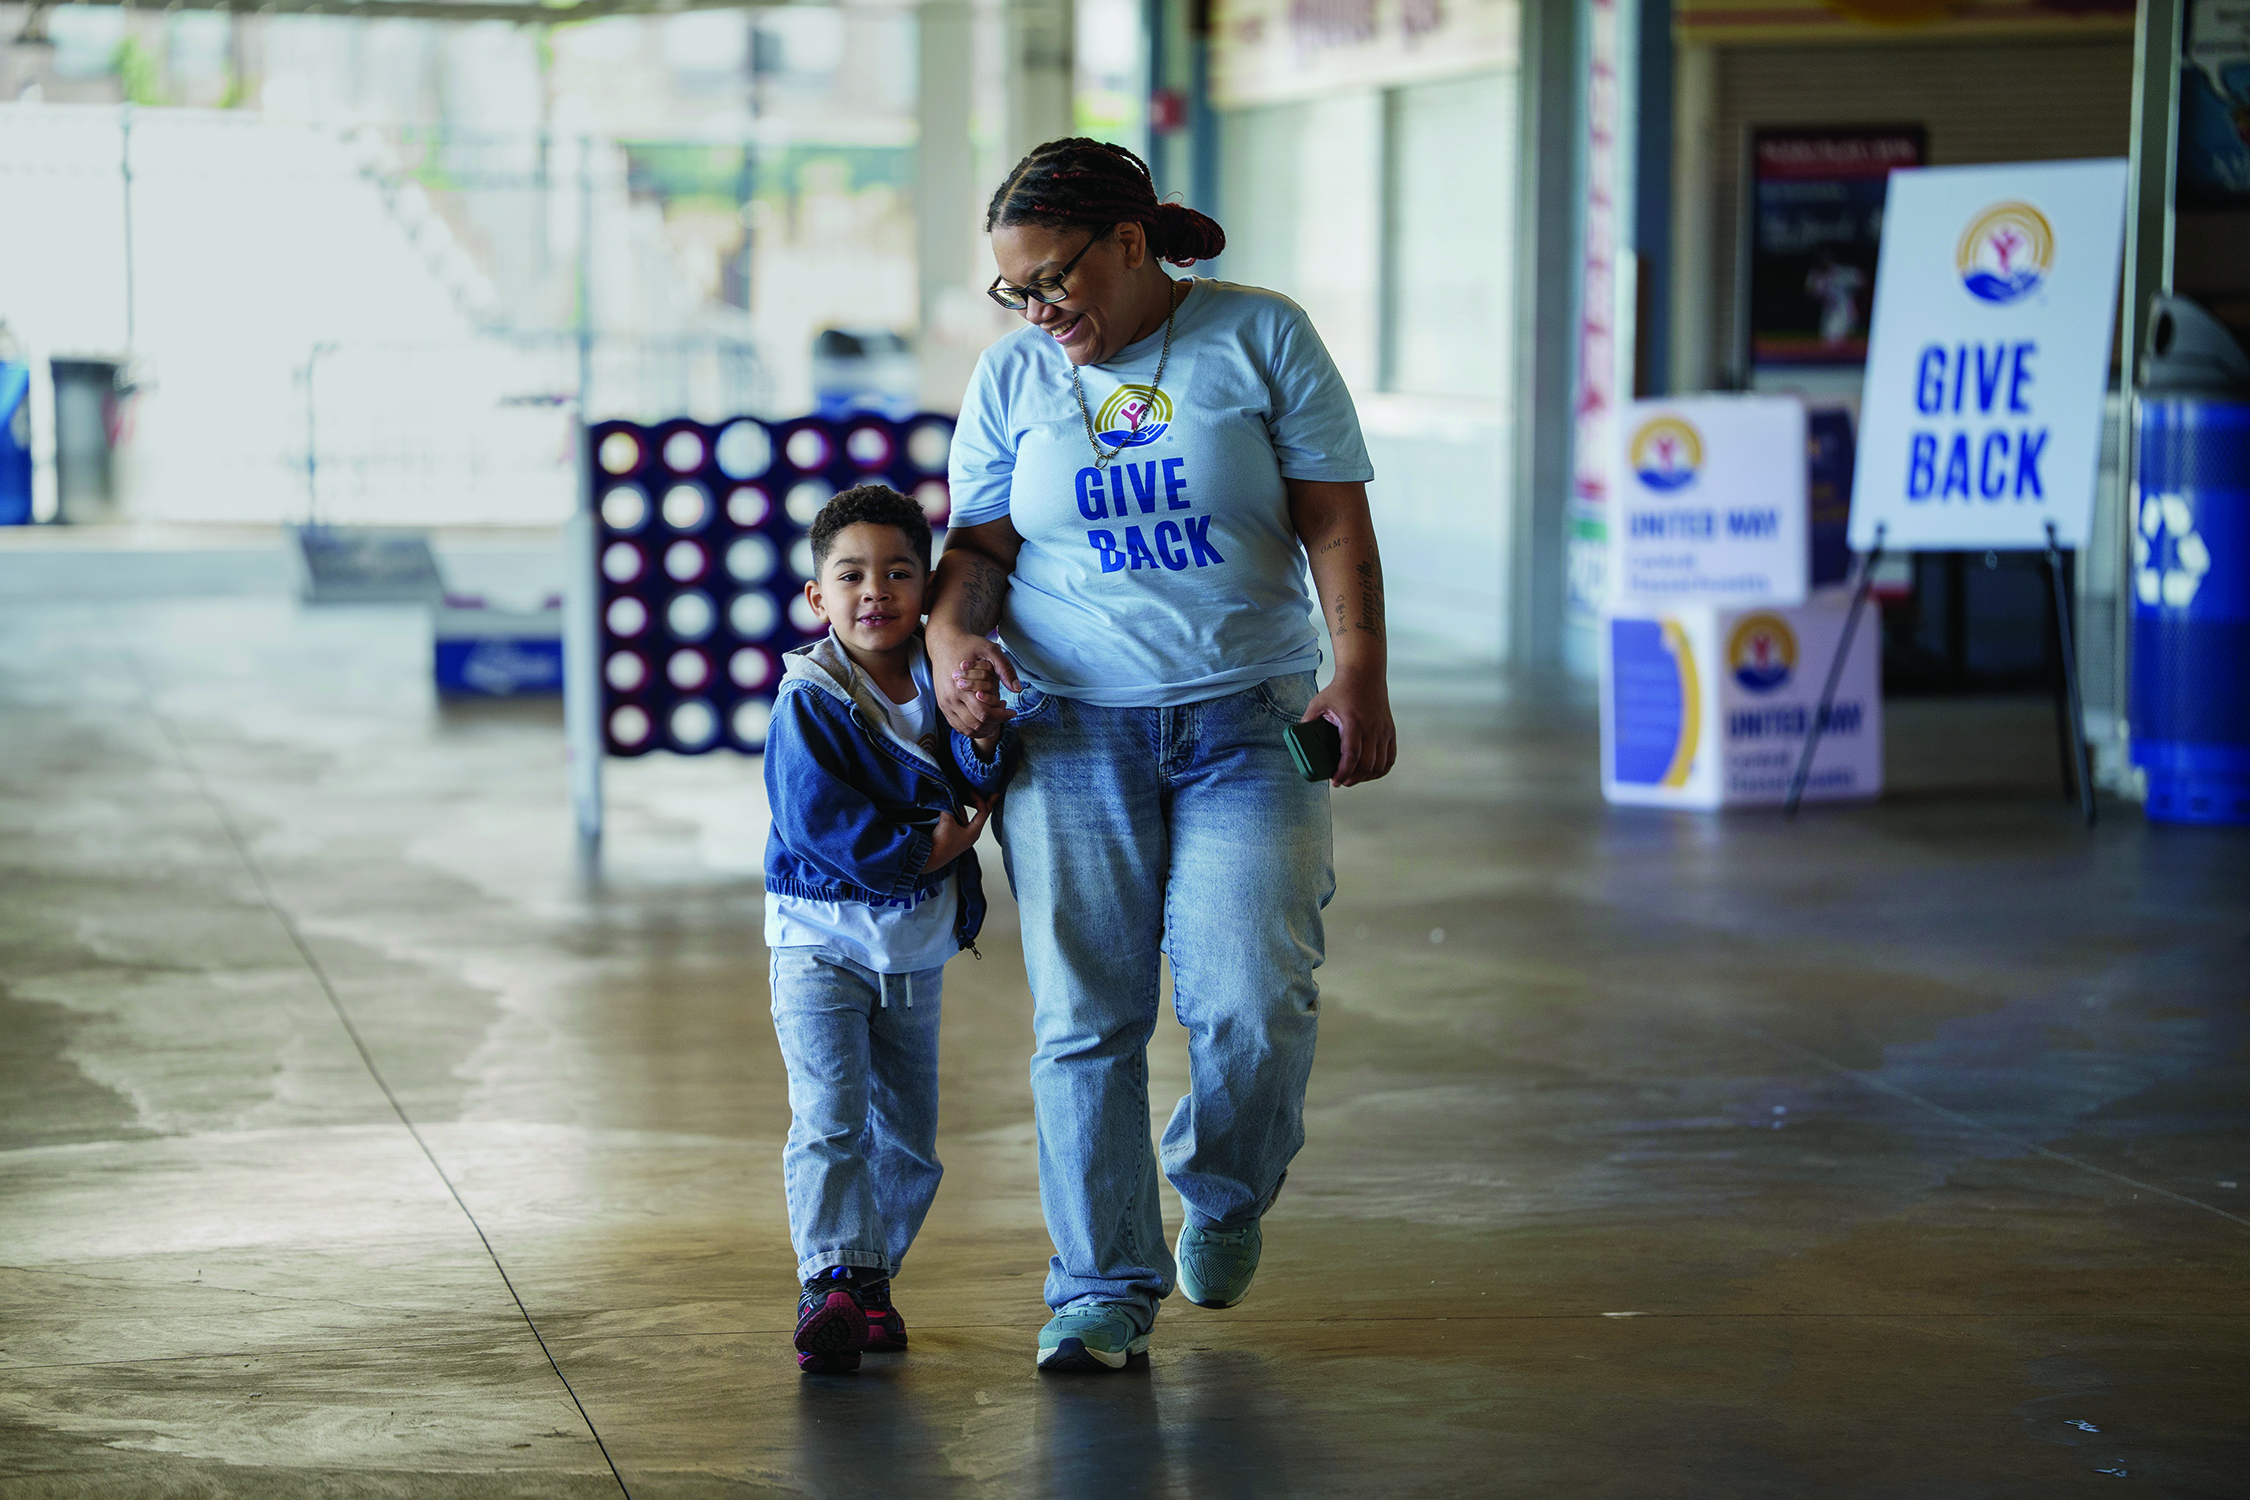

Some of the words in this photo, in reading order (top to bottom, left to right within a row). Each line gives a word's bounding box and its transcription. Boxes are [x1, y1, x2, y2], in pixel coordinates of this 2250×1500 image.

[1914, 340, 2037, 416] GIVE
[1075, 457, 1191, 521] GIVE
[1908, 427, 2048, 501] BACK
[1087, 515, 1225, 573] BACK
